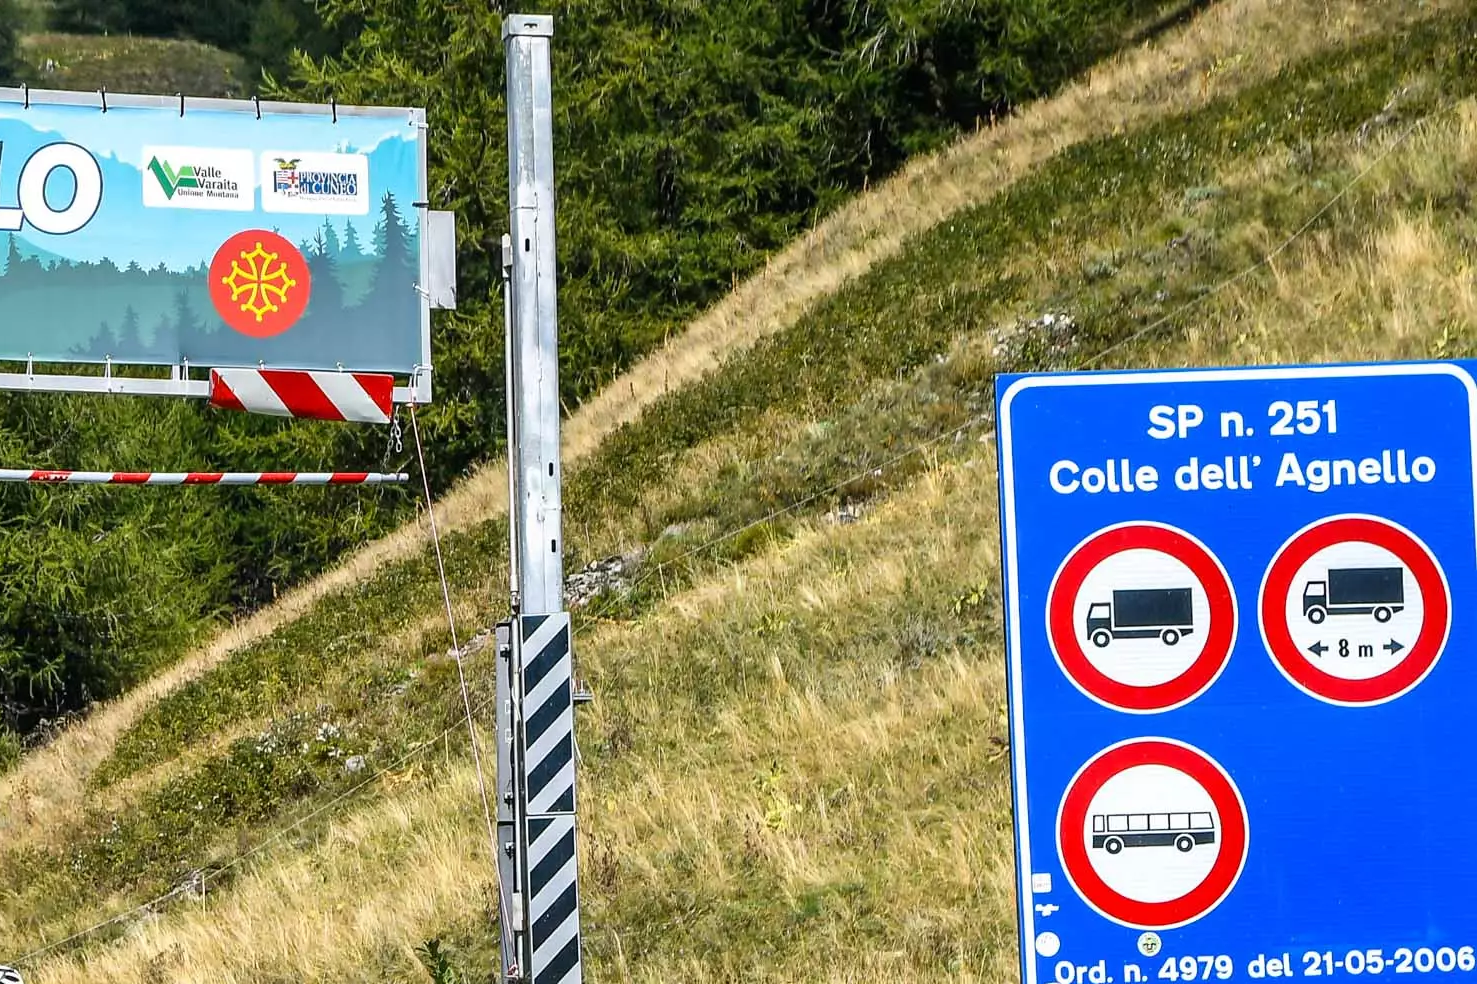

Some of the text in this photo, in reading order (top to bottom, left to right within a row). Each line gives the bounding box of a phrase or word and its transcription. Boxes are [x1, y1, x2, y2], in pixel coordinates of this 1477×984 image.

[193, 166, 222, 179] Valle
[299, 171, 357, 185] PROVINCIA
[197, 178, 238, 191] Varaita
[299, 182, 357, 195] di CUNEO
[177, 188, 239, 199] Unione Montana
[1147, 400, 1338, 439] SP n. 251
[1049, 448, 1437, 494] Colle dell' Agnello
[1338, 638, 1374, 658] 8 m
[1054, 945, 1476, 984] Ord. n. 4979 del 21-05-2006
